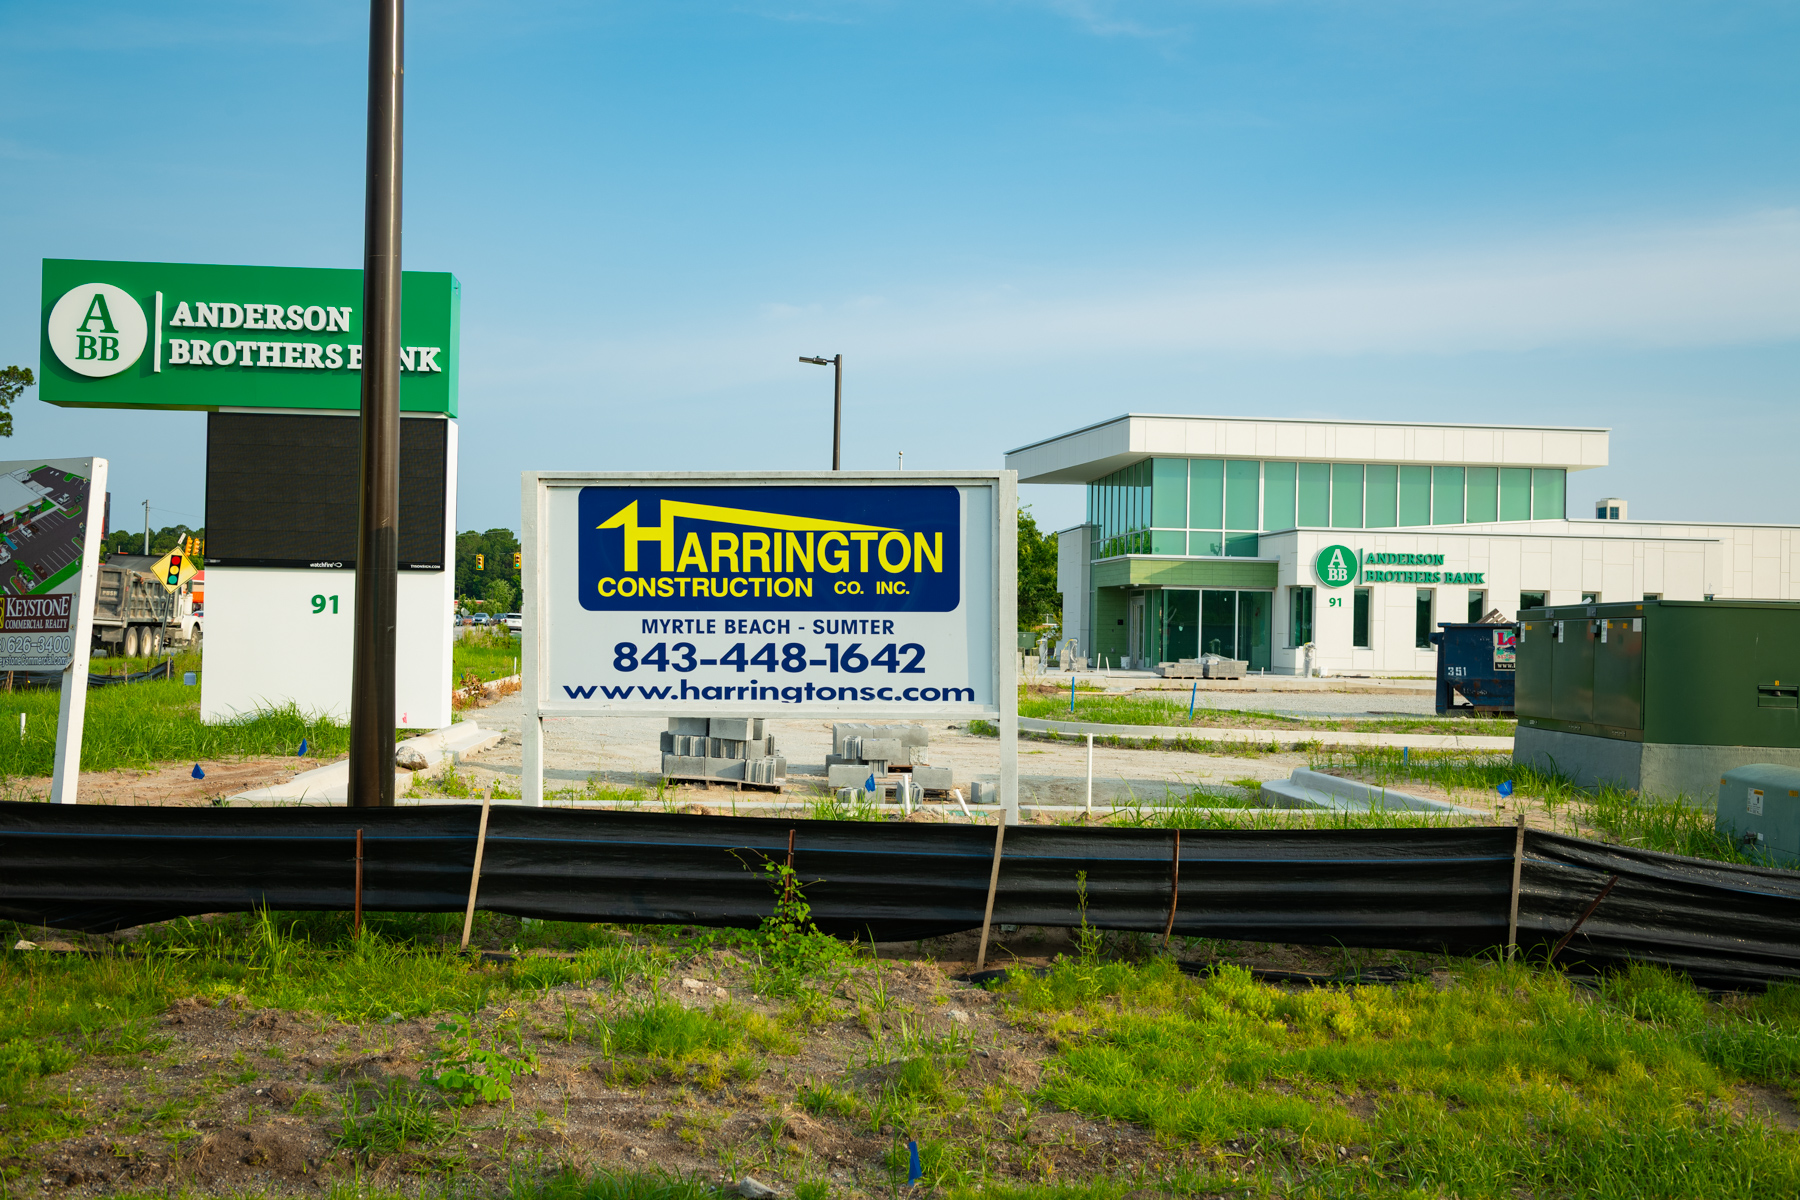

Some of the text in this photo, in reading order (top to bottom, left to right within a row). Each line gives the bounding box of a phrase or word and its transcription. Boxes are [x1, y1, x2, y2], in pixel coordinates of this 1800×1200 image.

[76, 294, 119, 334] A
[169, 301, 352, 332] ANDERSON
[75, 335, 120, 361] BB
[168, 338, 442, 373] BROTHERS BNK
[596, 499, 943, 574] HARRINGTON
[1328, 549, 1347, 568] A
[1366, 552, 1445, 566] ANDERSON
[1327, 568, 1348, 581] BB
[1365, 570, 1485, 585] BROTHERS BANK
[597, 576, 910, 598] CONSTRUCTION CO. INC.
[6, 596, 70, 617] KEYSTONE
[311, 594, 339, 615] 91
[1328, 597, 1342, 608] 91
[5, 619, 68, 629] COMMERCIAL REALTY
[641, 618, 716, 634] MYRTLE
[724, 618, 790, 635] BEACH
[812, 619, 895, 635] SUMTER
[612, 641, 926, 674] 843-448-1642
[1447, 666, 1467, 677] 351
[562, 678, 975, 704] www.harringtonsc.com
